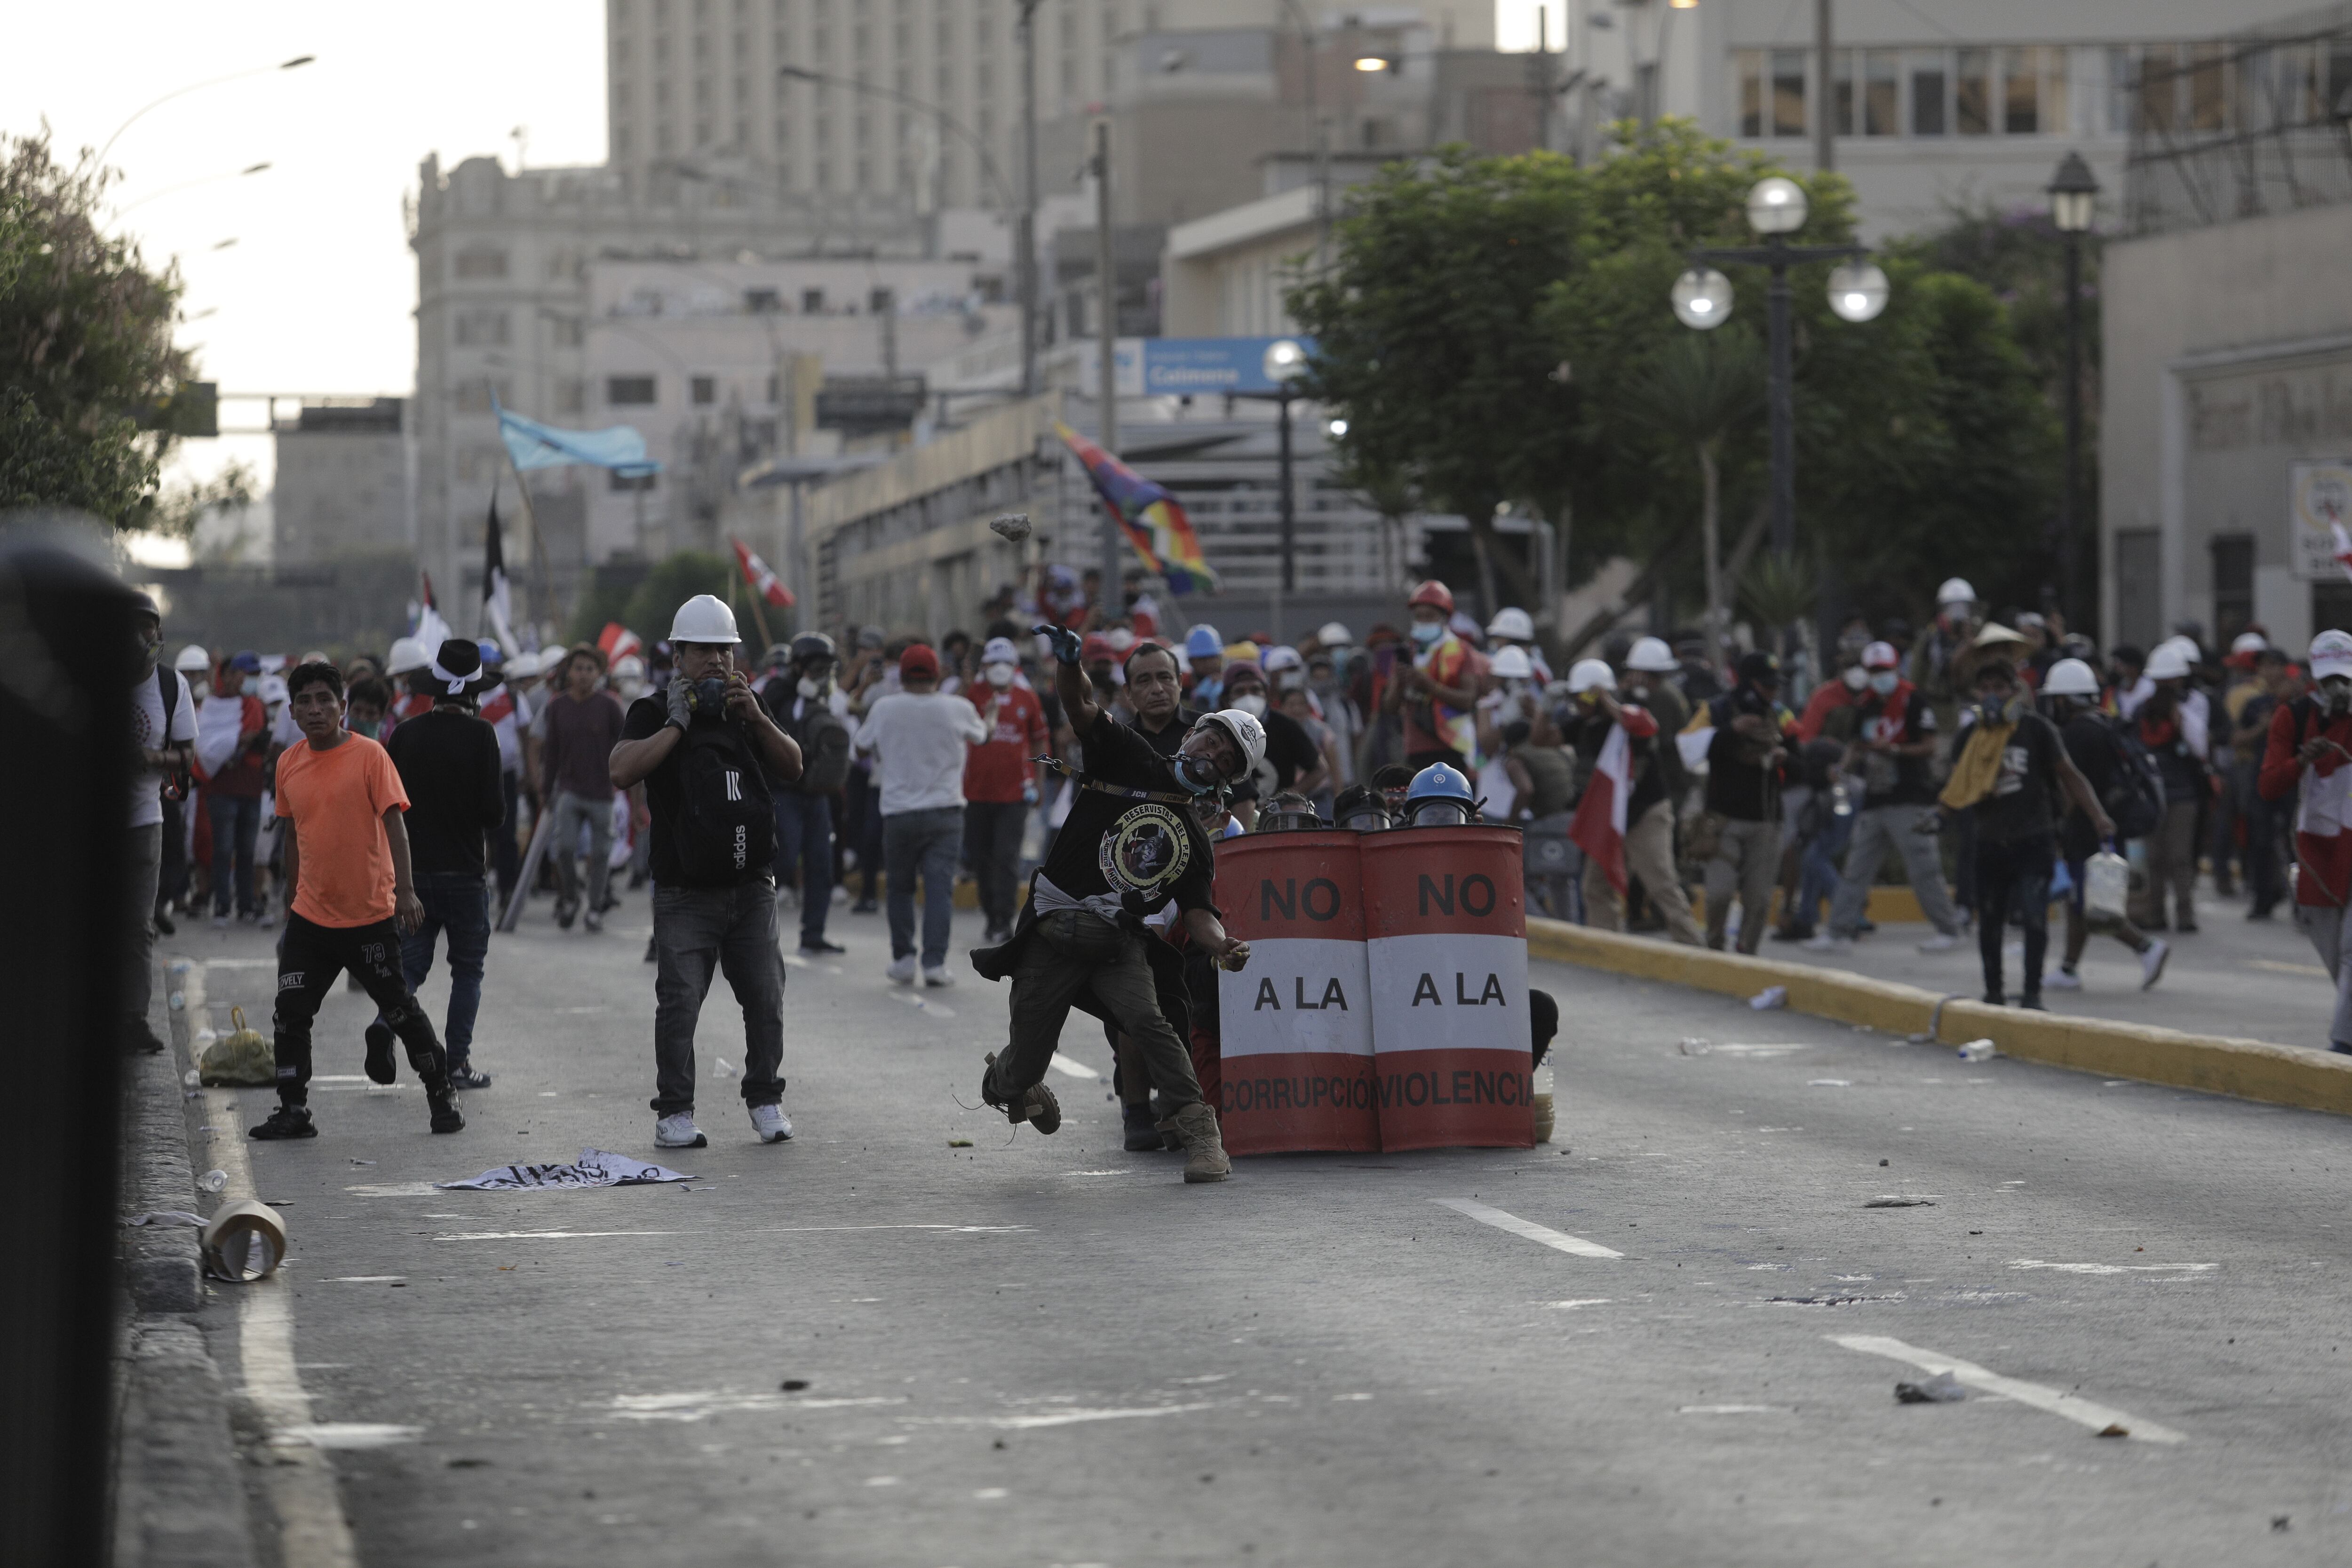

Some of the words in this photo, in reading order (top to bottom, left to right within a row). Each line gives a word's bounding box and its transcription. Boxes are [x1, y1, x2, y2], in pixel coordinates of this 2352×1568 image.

[1123, 805, 1174, 822] RESERVISTAS
[1175, 822, 1185, 839] DEL
[734, 825, 746, 869] adidas
[1108, 871, 1129, 892] HONOR
[1143, 889, 1155, 898] LTAD
[1418, 874, 1496, 916] NO
[1262, 878, 1340, 922] NO
[1254, 977, 1280, 1011] A
[1296, 977, 1348, 1011] LA
[1412, 973, 1442, 1006] A
[1456, 972, 1506, 1006] LA
